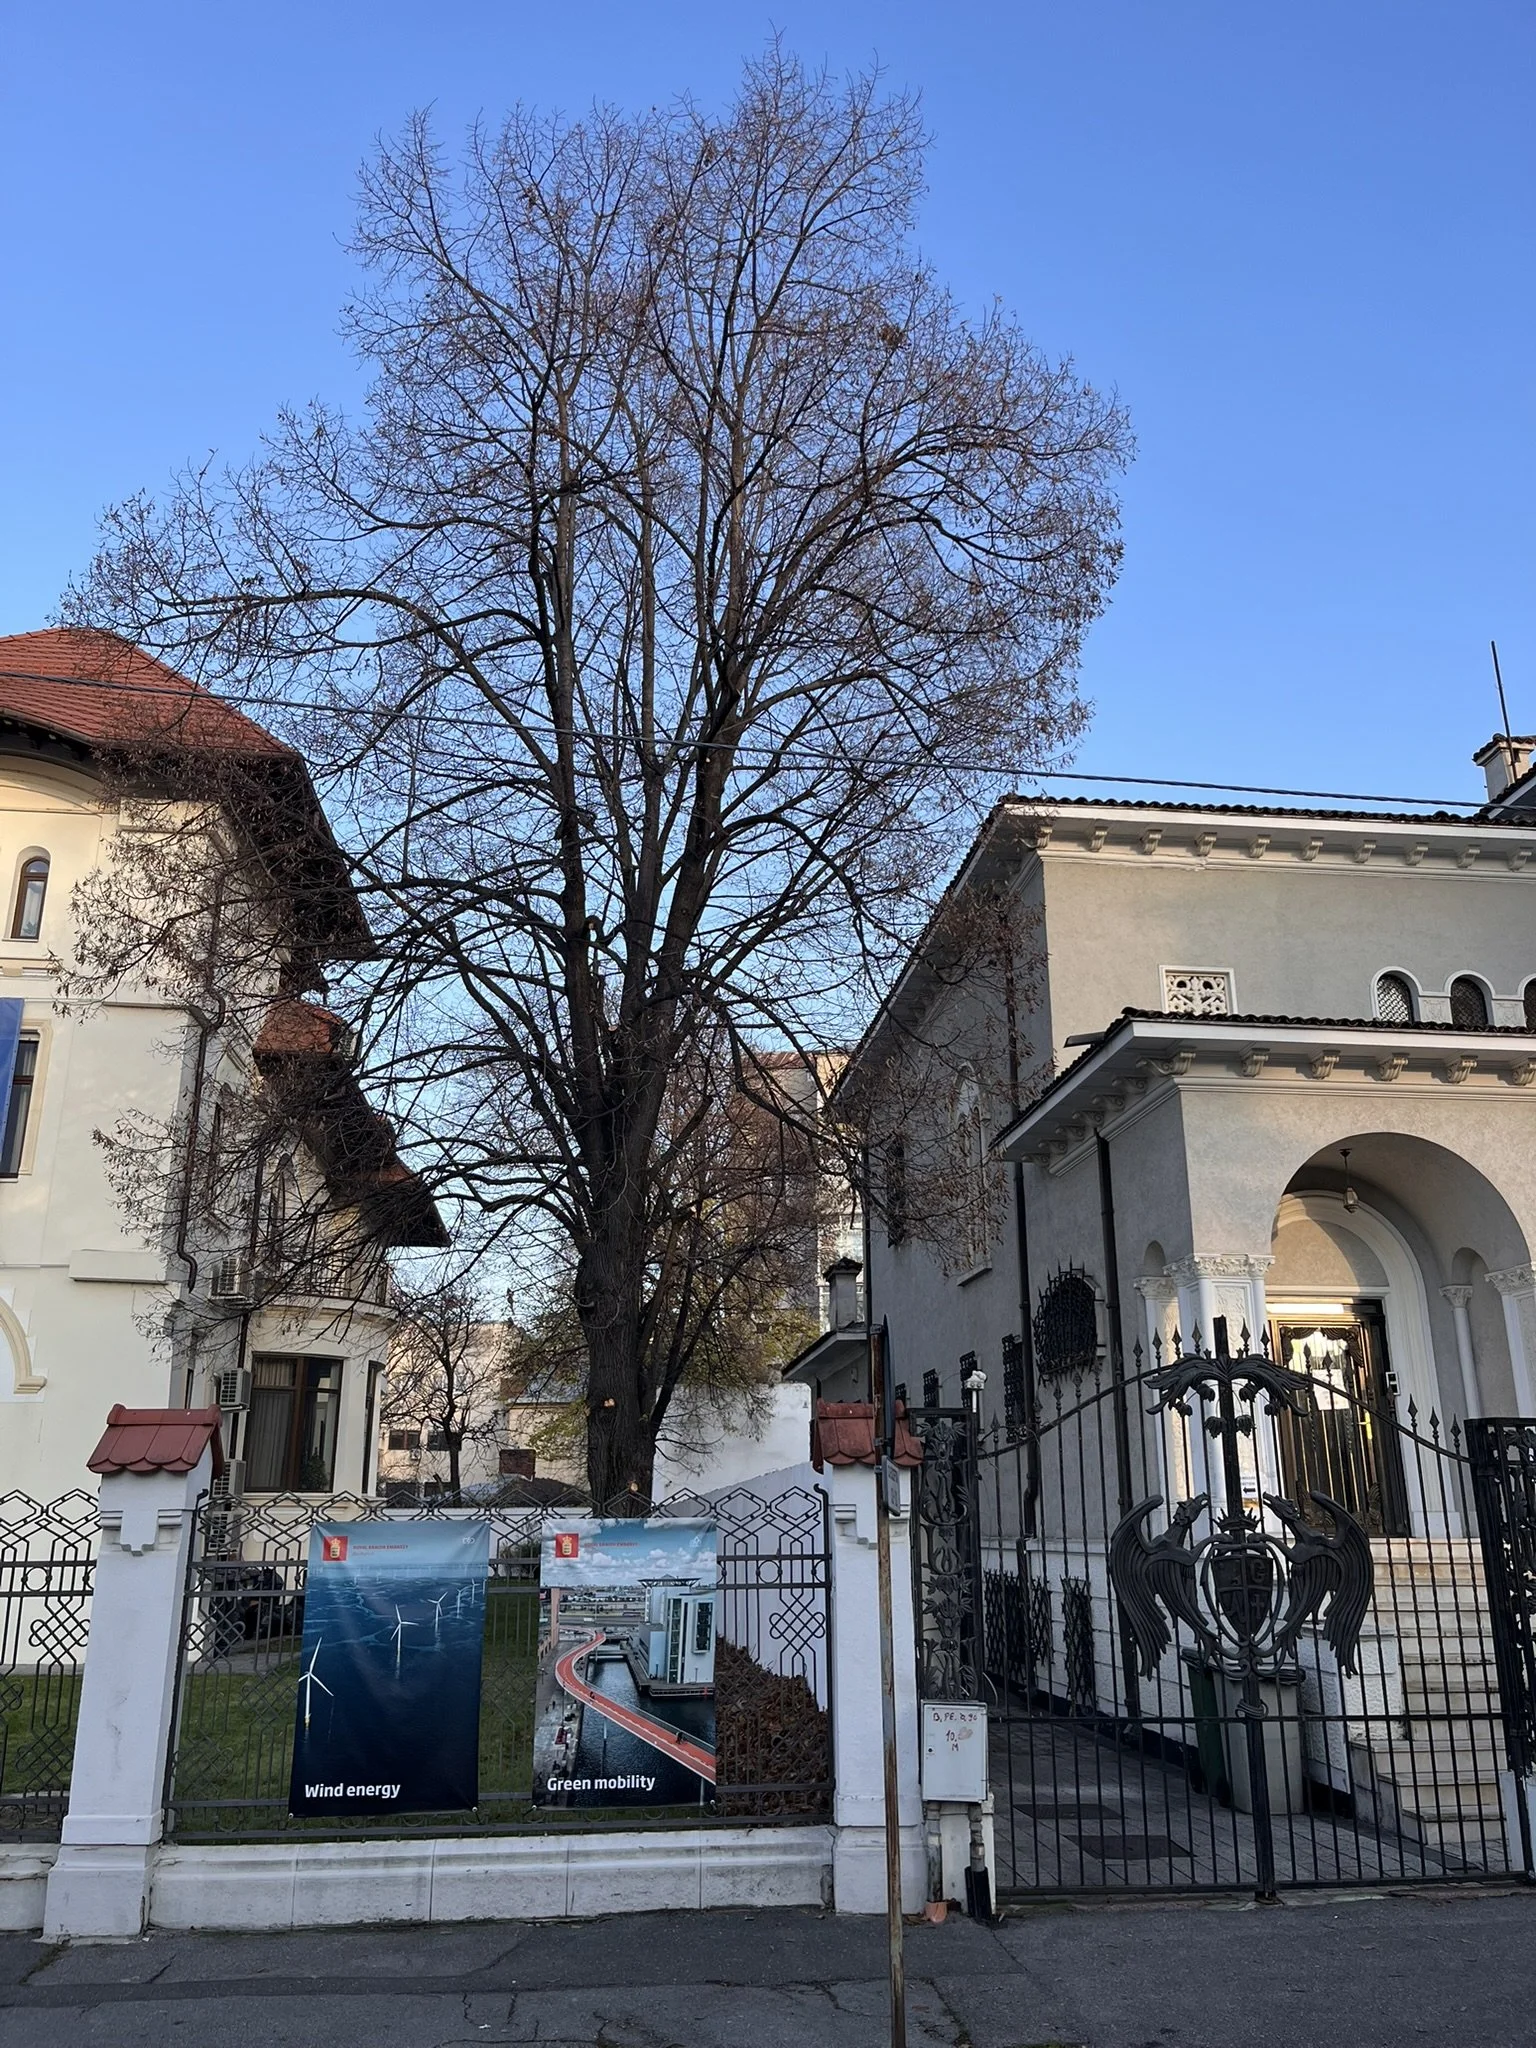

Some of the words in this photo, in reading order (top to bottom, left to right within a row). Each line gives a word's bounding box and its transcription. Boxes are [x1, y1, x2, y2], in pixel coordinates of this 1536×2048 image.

[305, 1782, 344, 1798] Wind
[346, 1784, 401, 1799] energy
[547, 1777, 591, 1791] Green
[594, 1774, 656, 1792] mobility
